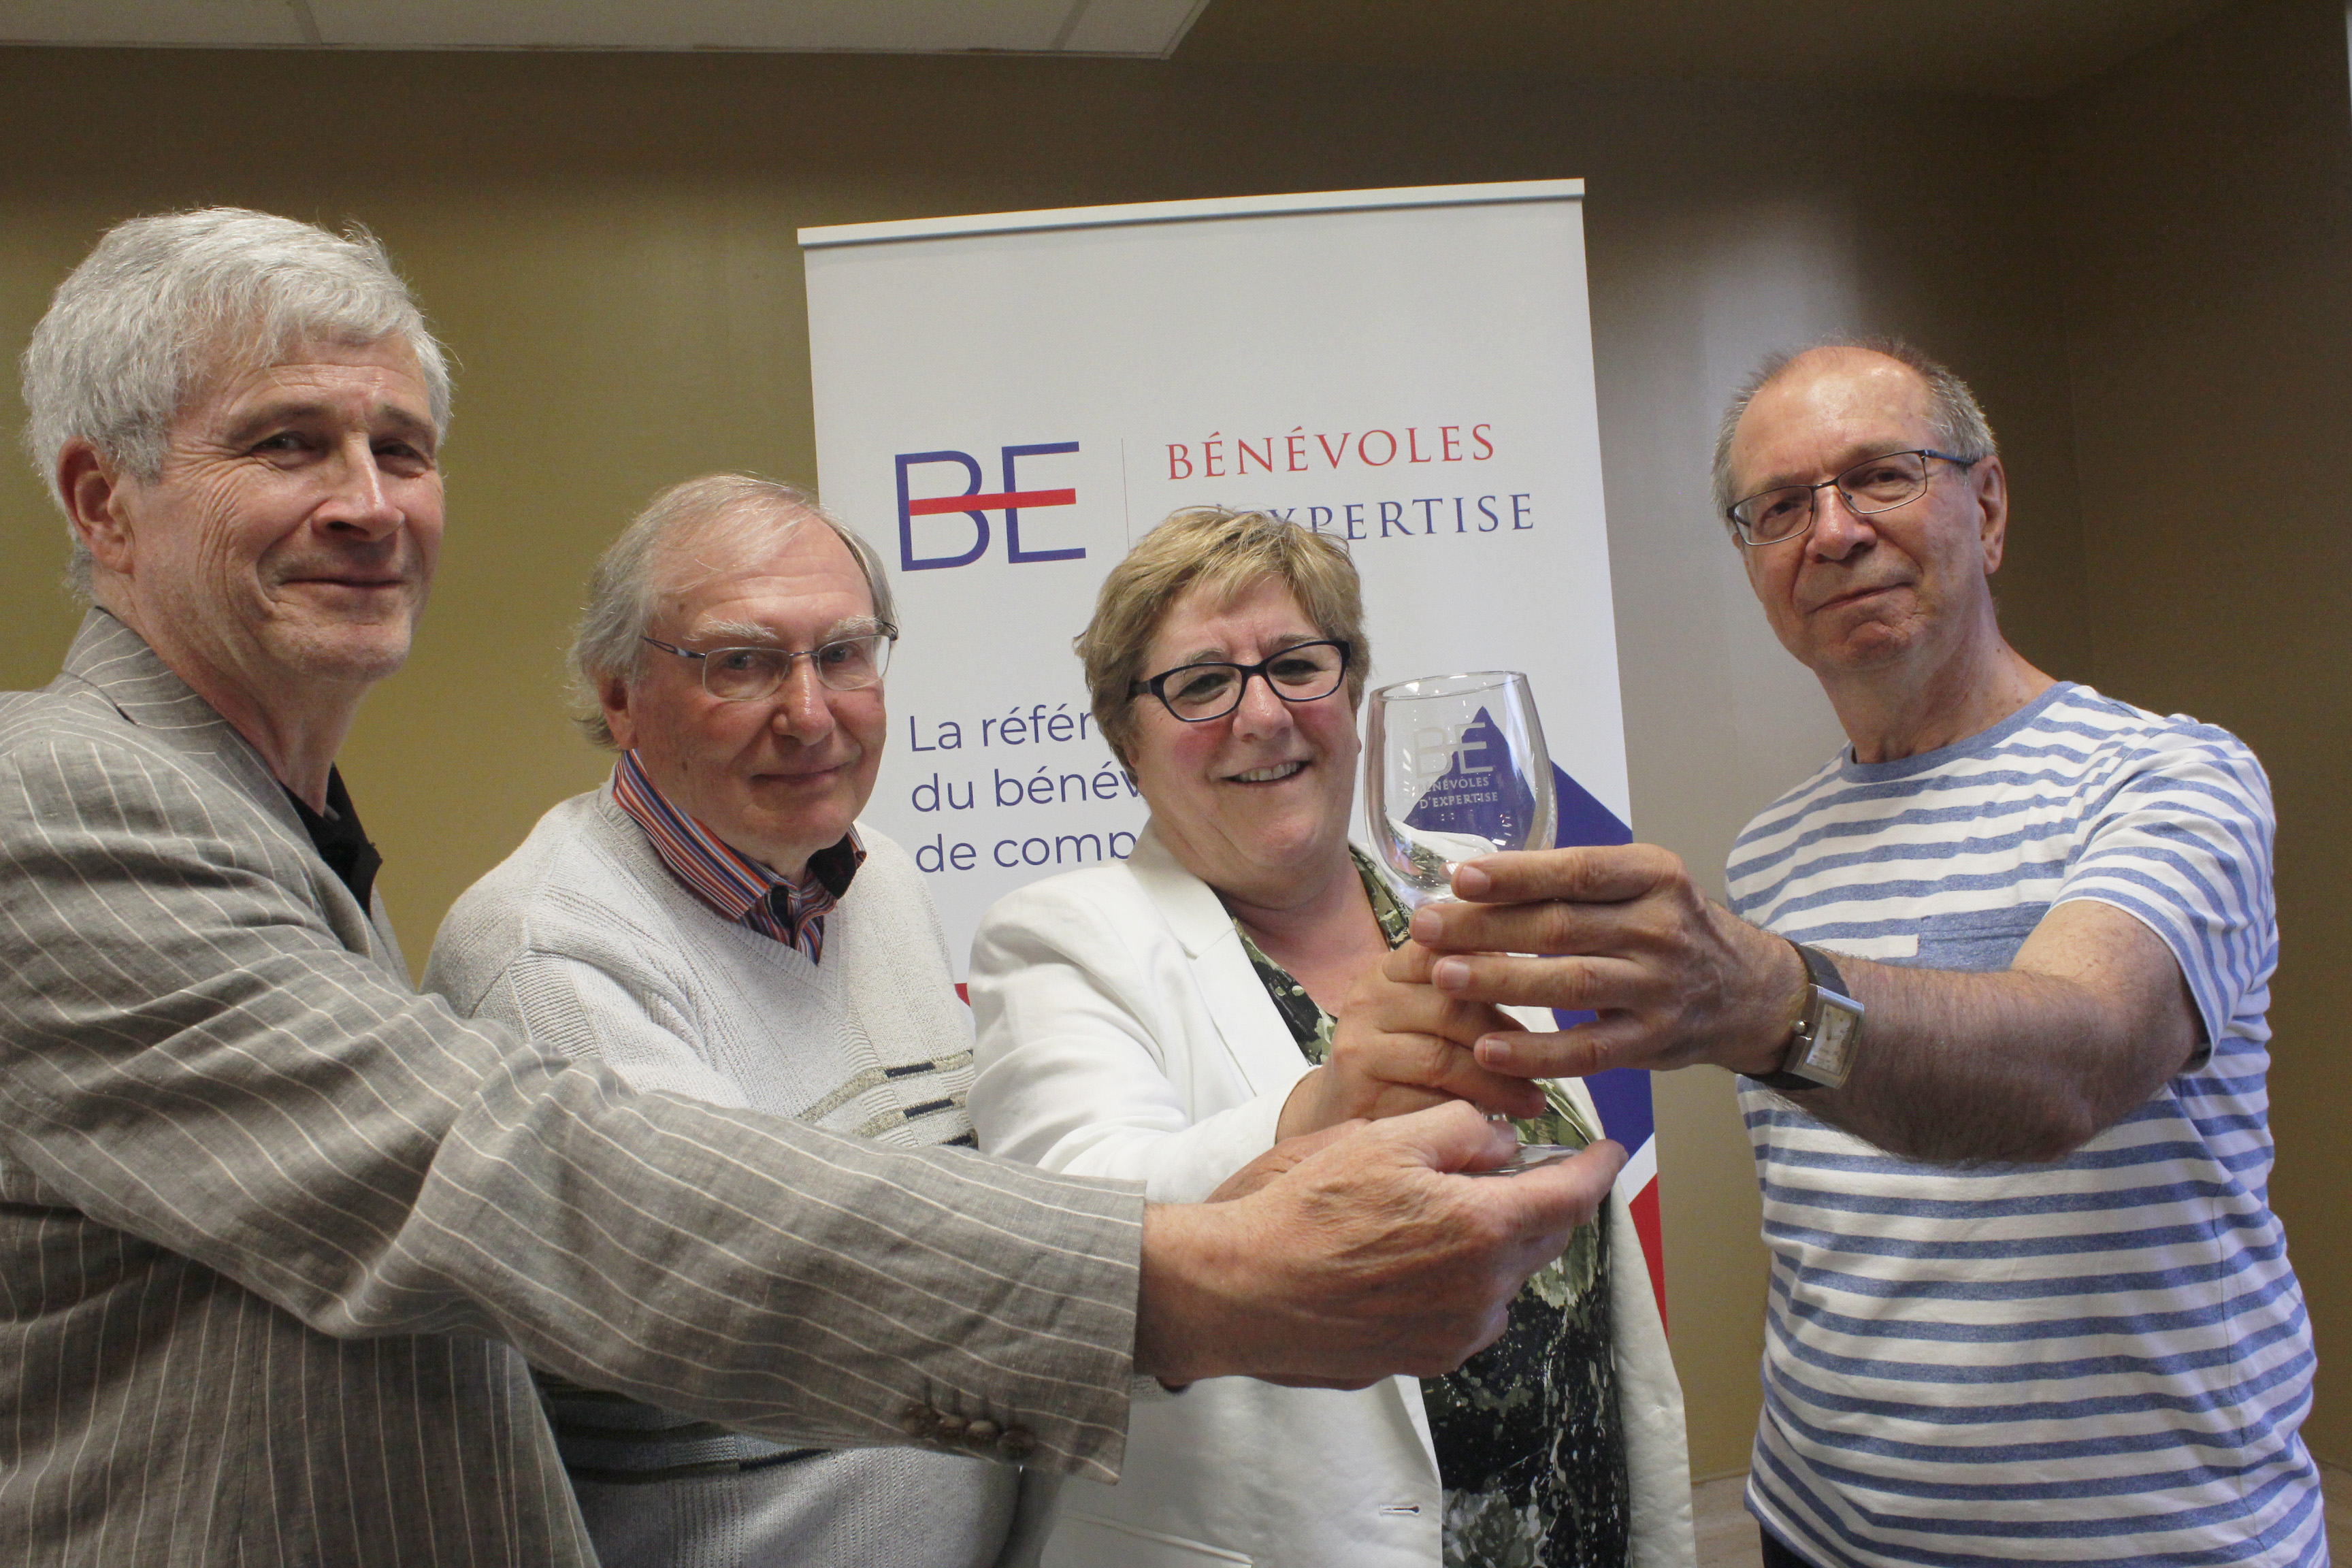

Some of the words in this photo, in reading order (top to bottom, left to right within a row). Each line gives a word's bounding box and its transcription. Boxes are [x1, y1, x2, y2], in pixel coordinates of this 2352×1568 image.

[1165, 423, 1494, 480] BÉNÉVOLES
[894, 441, 1086, 572] BE
[910, 715, 962, 752] La
[981, 703, 1094, 747] référ
[1414, 721, 1494, 779] BE
[911, 772, 975, 813] du
[994, 761, 1140, 807] bénév
[1419, 791, 1498, 809] D'EXPERTISE
[915, 833, 977, 873] de
[994, 831, 1137, 868] comp
